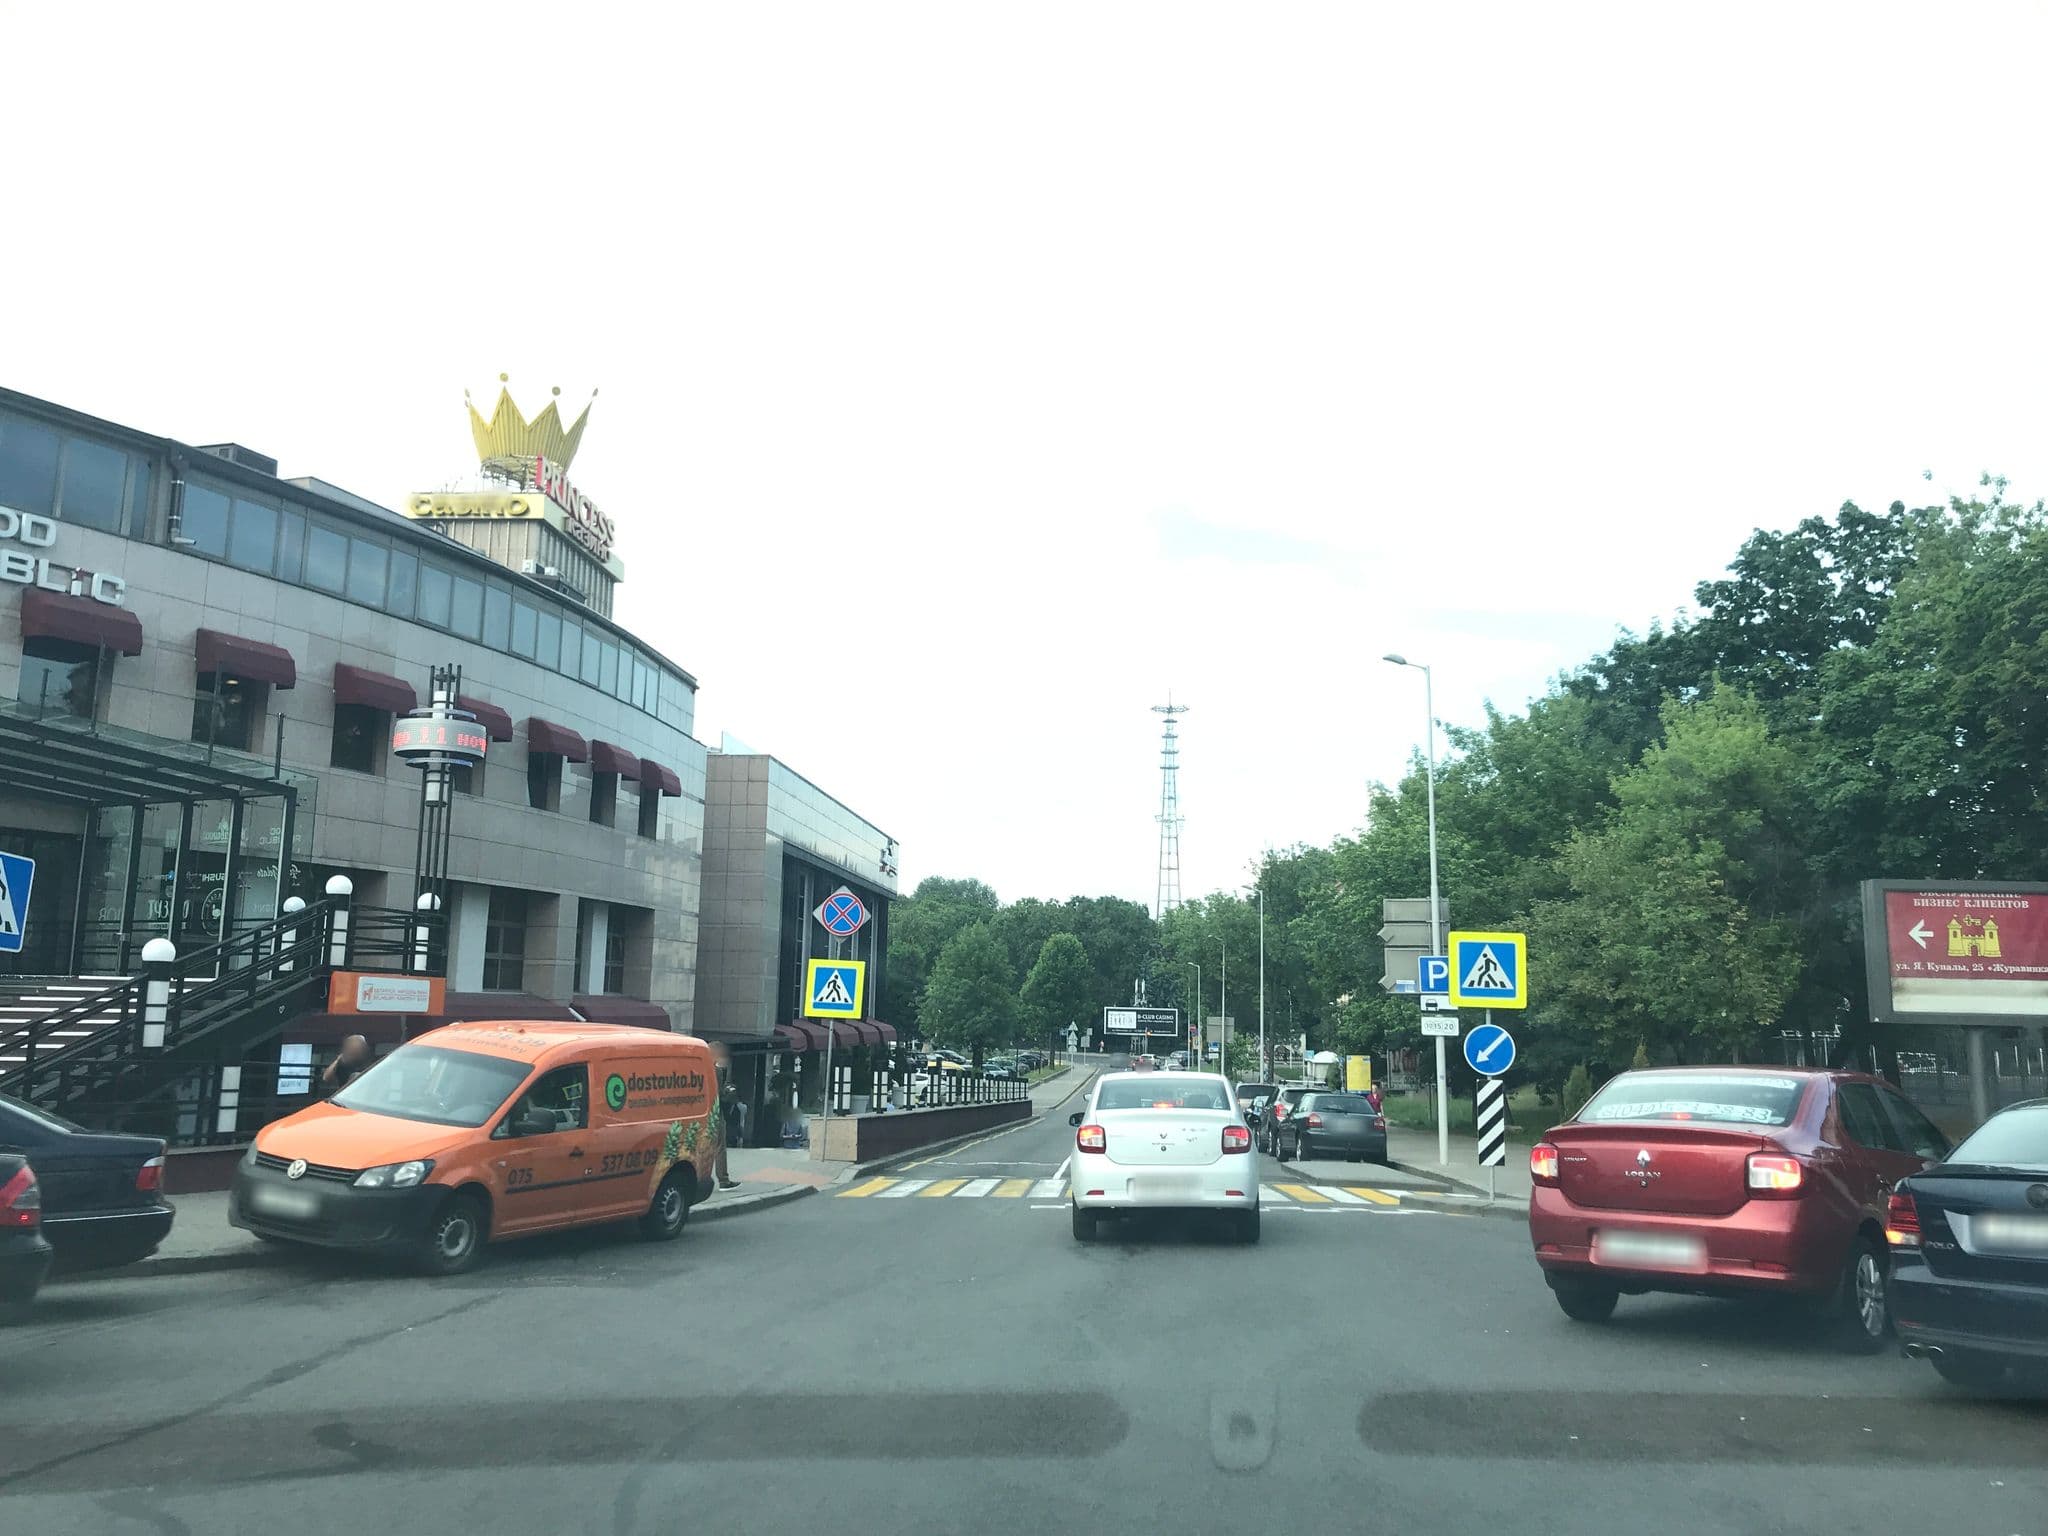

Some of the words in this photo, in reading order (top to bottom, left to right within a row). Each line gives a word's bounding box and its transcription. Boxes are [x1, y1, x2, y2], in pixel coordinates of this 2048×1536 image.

[535, 453, 616, 548] PRINCESS
[1913, 898, 1960, 907] БИЗНЕС
[1964, 900, 2029, 909] КЛИЕНТОВ
[1427, 960, 1449, 989] P
[1972, 963, 1984, 971] 25
[628, 1070, 704, 1092] dostavka.by
[508, 1168, 533, 1185] 075
[1926, 1240, 1955, 1250] POLO
